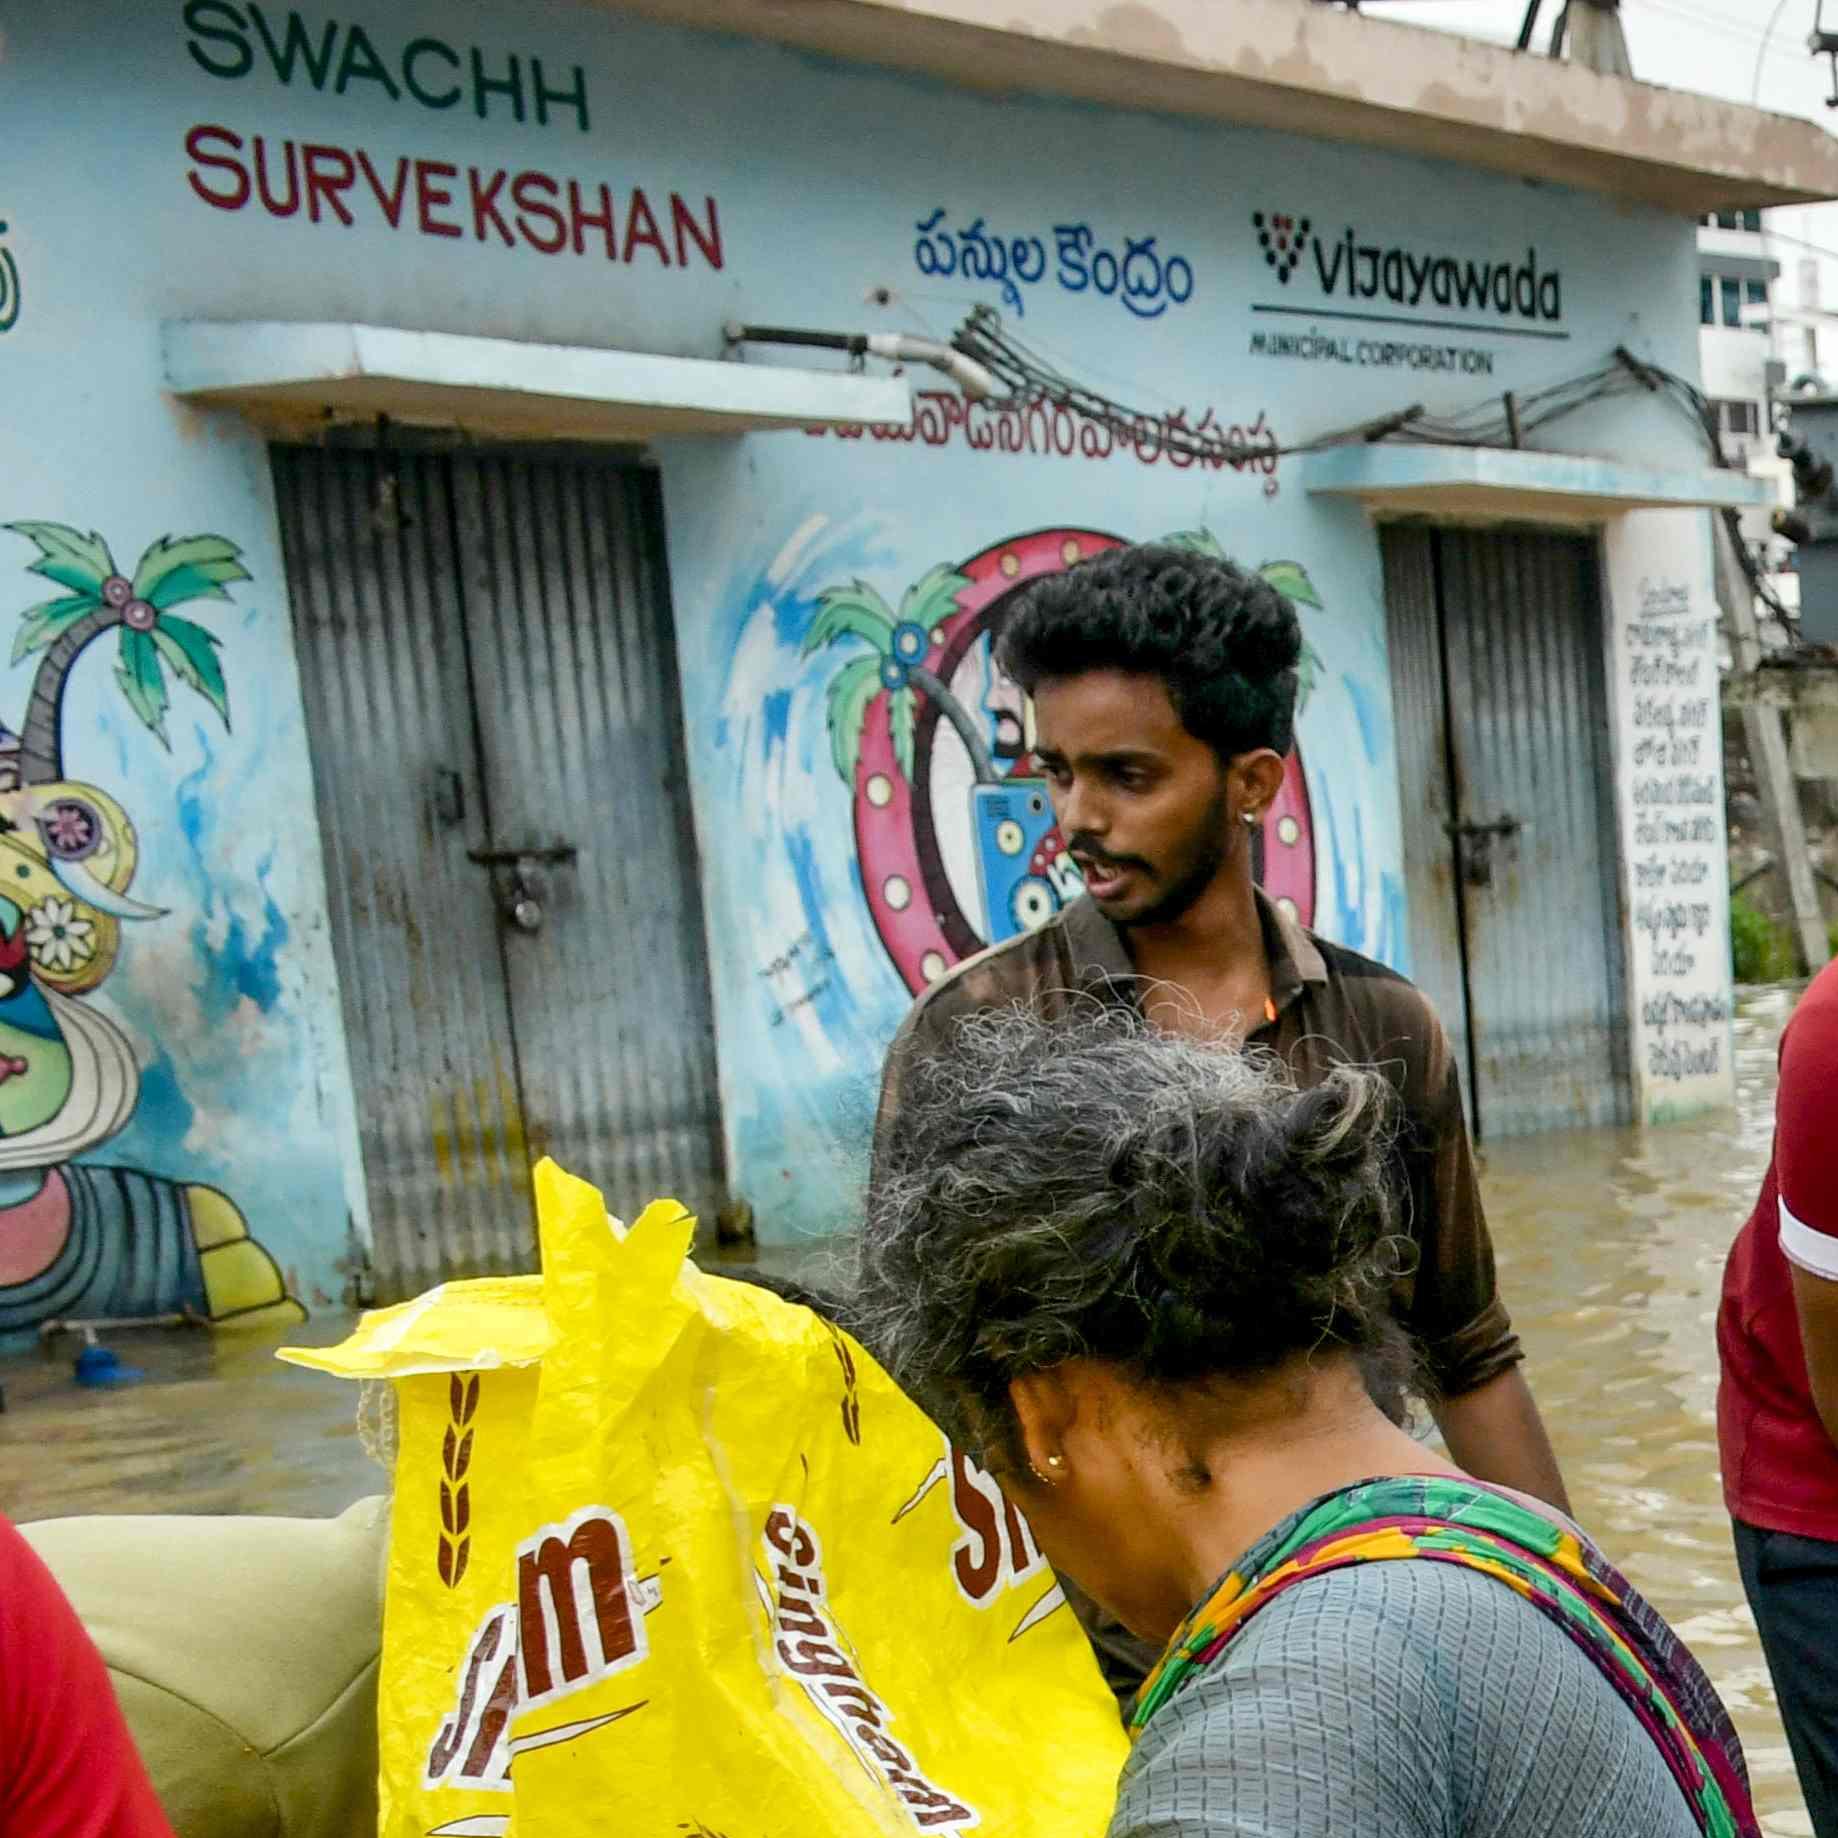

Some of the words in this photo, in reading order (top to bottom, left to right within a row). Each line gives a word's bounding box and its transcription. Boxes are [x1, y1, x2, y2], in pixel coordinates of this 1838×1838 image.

[183, 0, 591, 132] SWACHH
[184, 124, 726, 271] SURVEKSHAN
[1250, 330, 1352, 364] MUNICIPAL
[1357, 339, 1494, 376] CORPORATION
